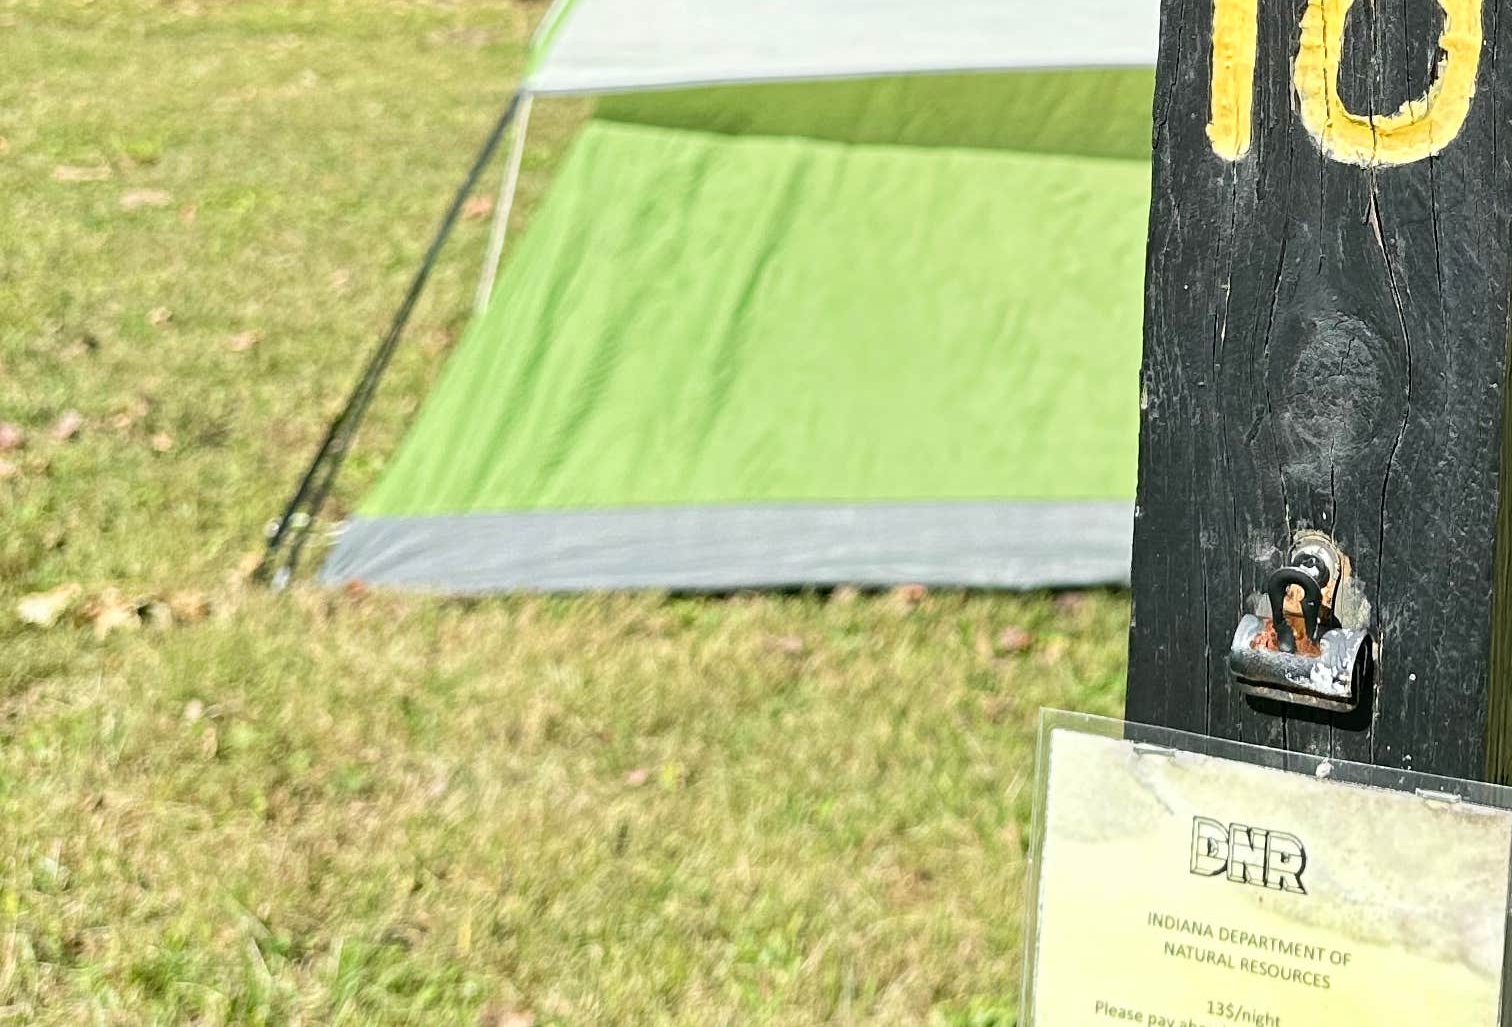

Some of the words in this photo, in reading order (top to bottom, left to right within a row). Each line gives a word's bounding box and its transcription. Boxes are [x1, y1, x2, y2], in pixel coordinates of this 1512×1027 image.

[1190, 815, 1308, 895] DNR
[1147, 912, 1214, 939] INDIANA
[1219, 927, 1325, 962] DEPARTMENT
[1330, 950, 1352, 966] OF
[1164, 941, 1235, 969] NATURAL
[1240, 957, 1331, 989] RESOURCES
[1095, 1000, 1143, 1022] Please
[1207, 1000, 1281, 1027] 13$/night
